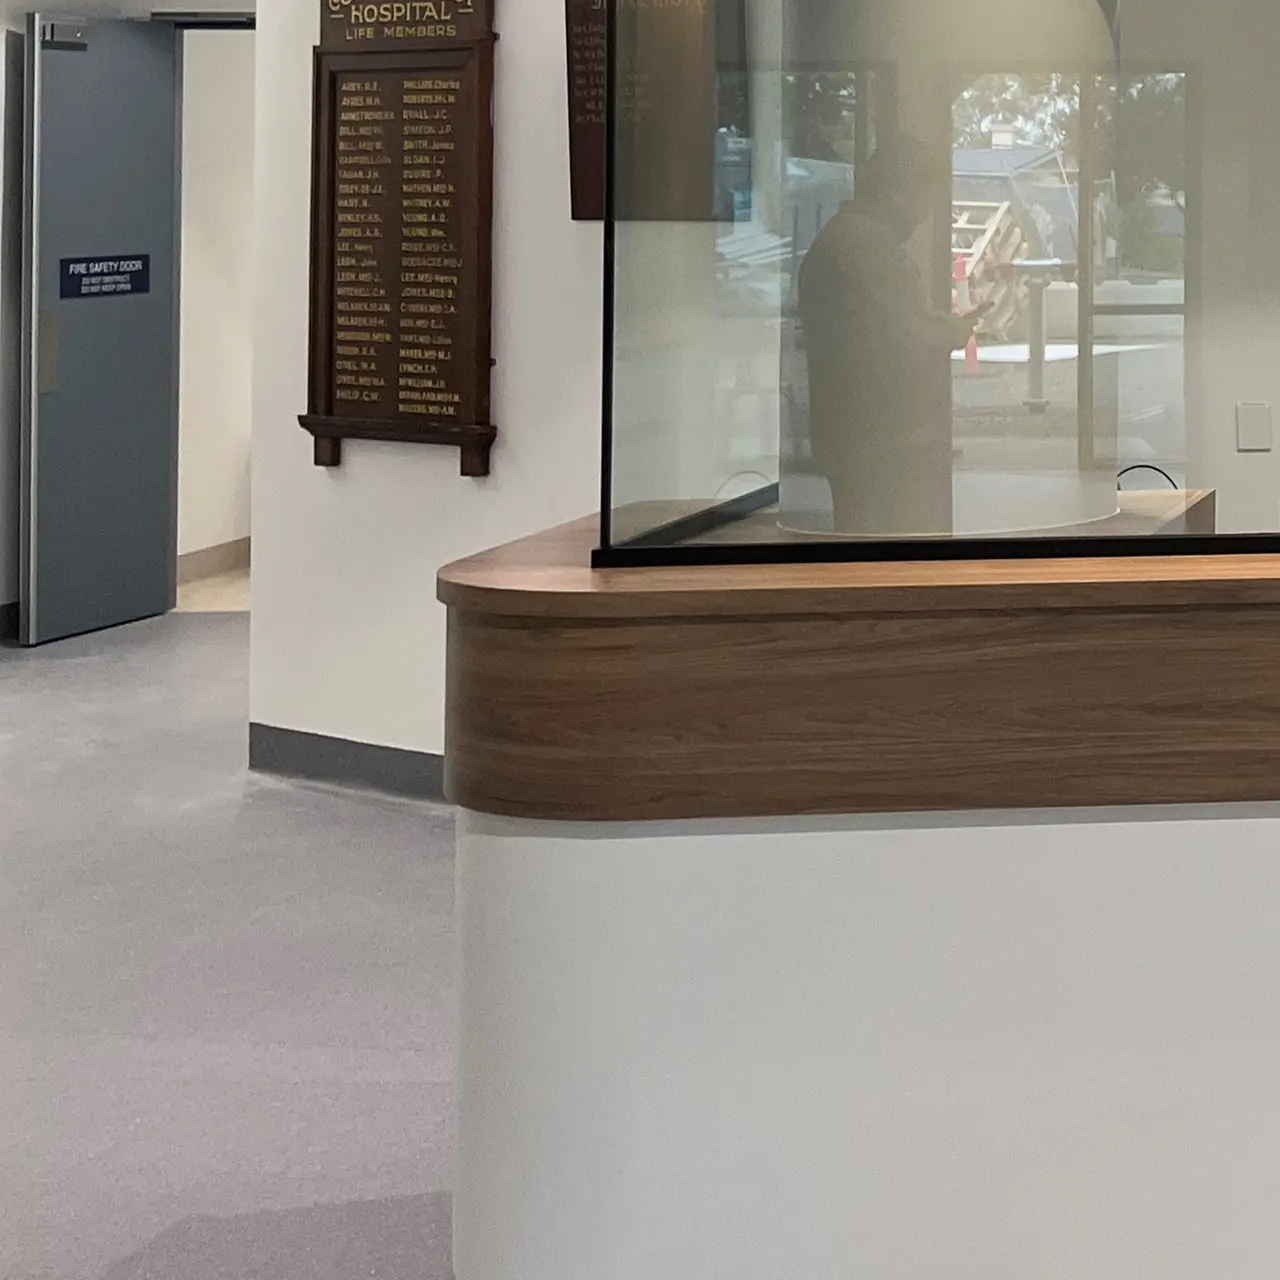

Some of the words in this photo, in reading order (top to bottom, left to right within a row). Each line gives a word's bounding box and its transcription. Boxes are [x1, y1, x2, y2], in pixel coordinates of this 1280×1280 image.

[350, 0, 452, 23] HOSPITAL
[345, 27, 375, 40] LIFE
[383, 24, 457, 38] MEMBERS
[69, 263, 88, 275] FIRE
[89, 261, 119, 273] SAFETY
[119, 260, 142, 271] DOOR
